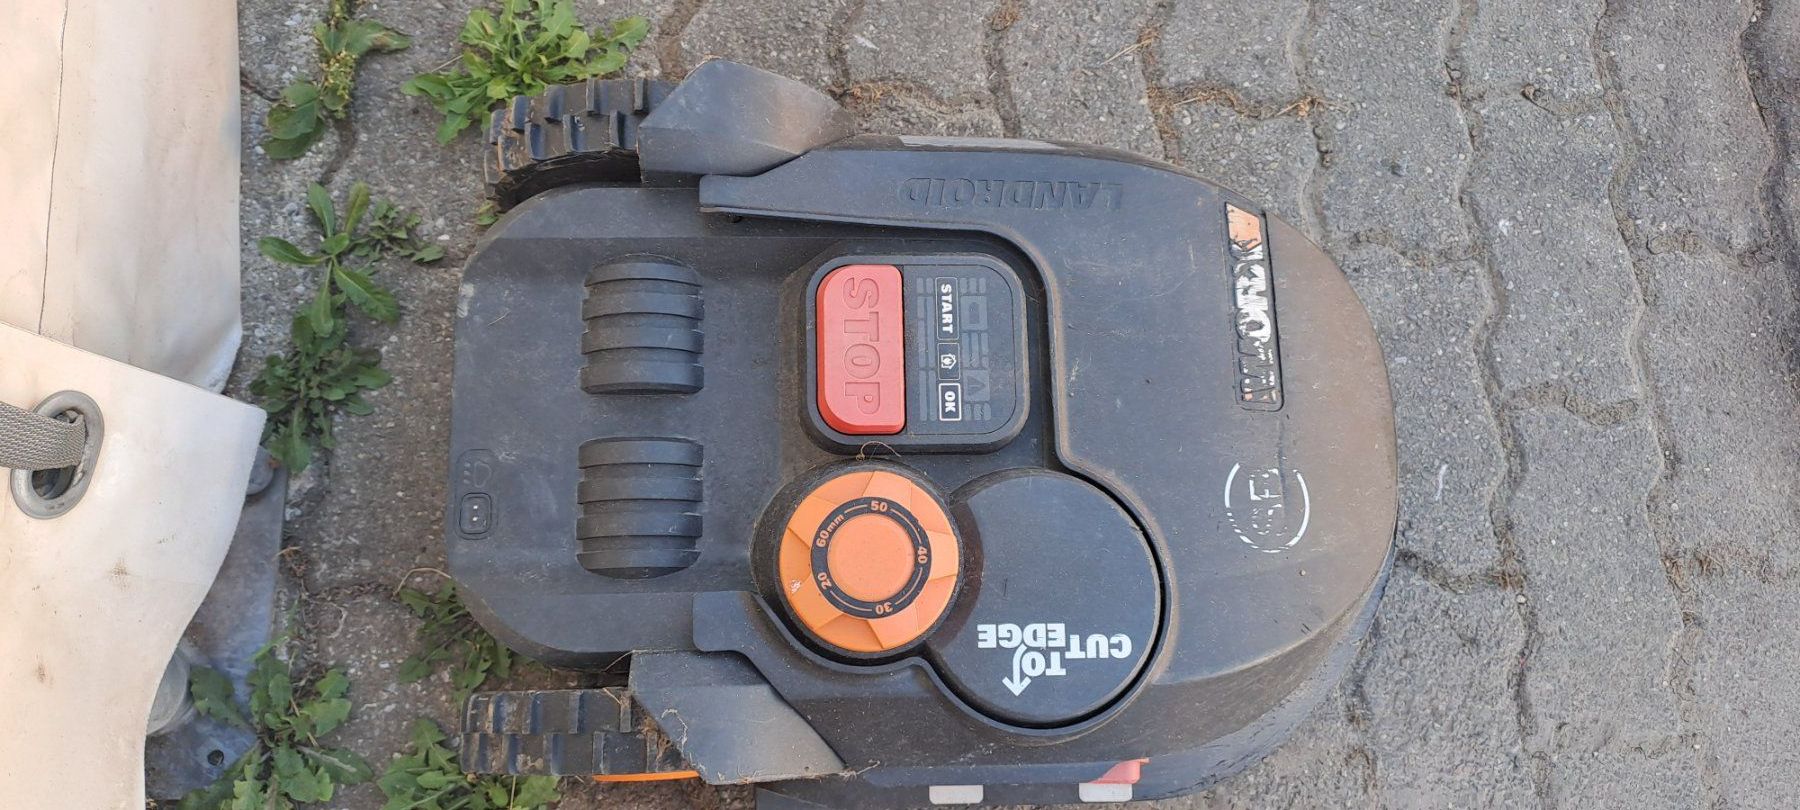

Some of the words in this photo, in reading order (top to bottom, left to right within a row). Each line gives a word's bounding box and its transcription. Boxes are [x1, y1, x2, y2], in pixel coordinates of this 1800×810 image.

[901, 177, 1123, 210] LANDROID
[940, 283, 954, 334] START
[843, 277, 881, 415] STOP
[944, 390, 956, 413] OK
[870, 501, 888, 513] 50
[816, 513, 845, 548] 60mm
[917, 546, 928, 564] 40
[817, 571, 832, 590] 20
[875, 601, 894, 615] 30
[977, 622, 1066, 649] EDGE
[1065, 633, 1133, 659] CUT
[1021, 651, 1067, 677] TO
